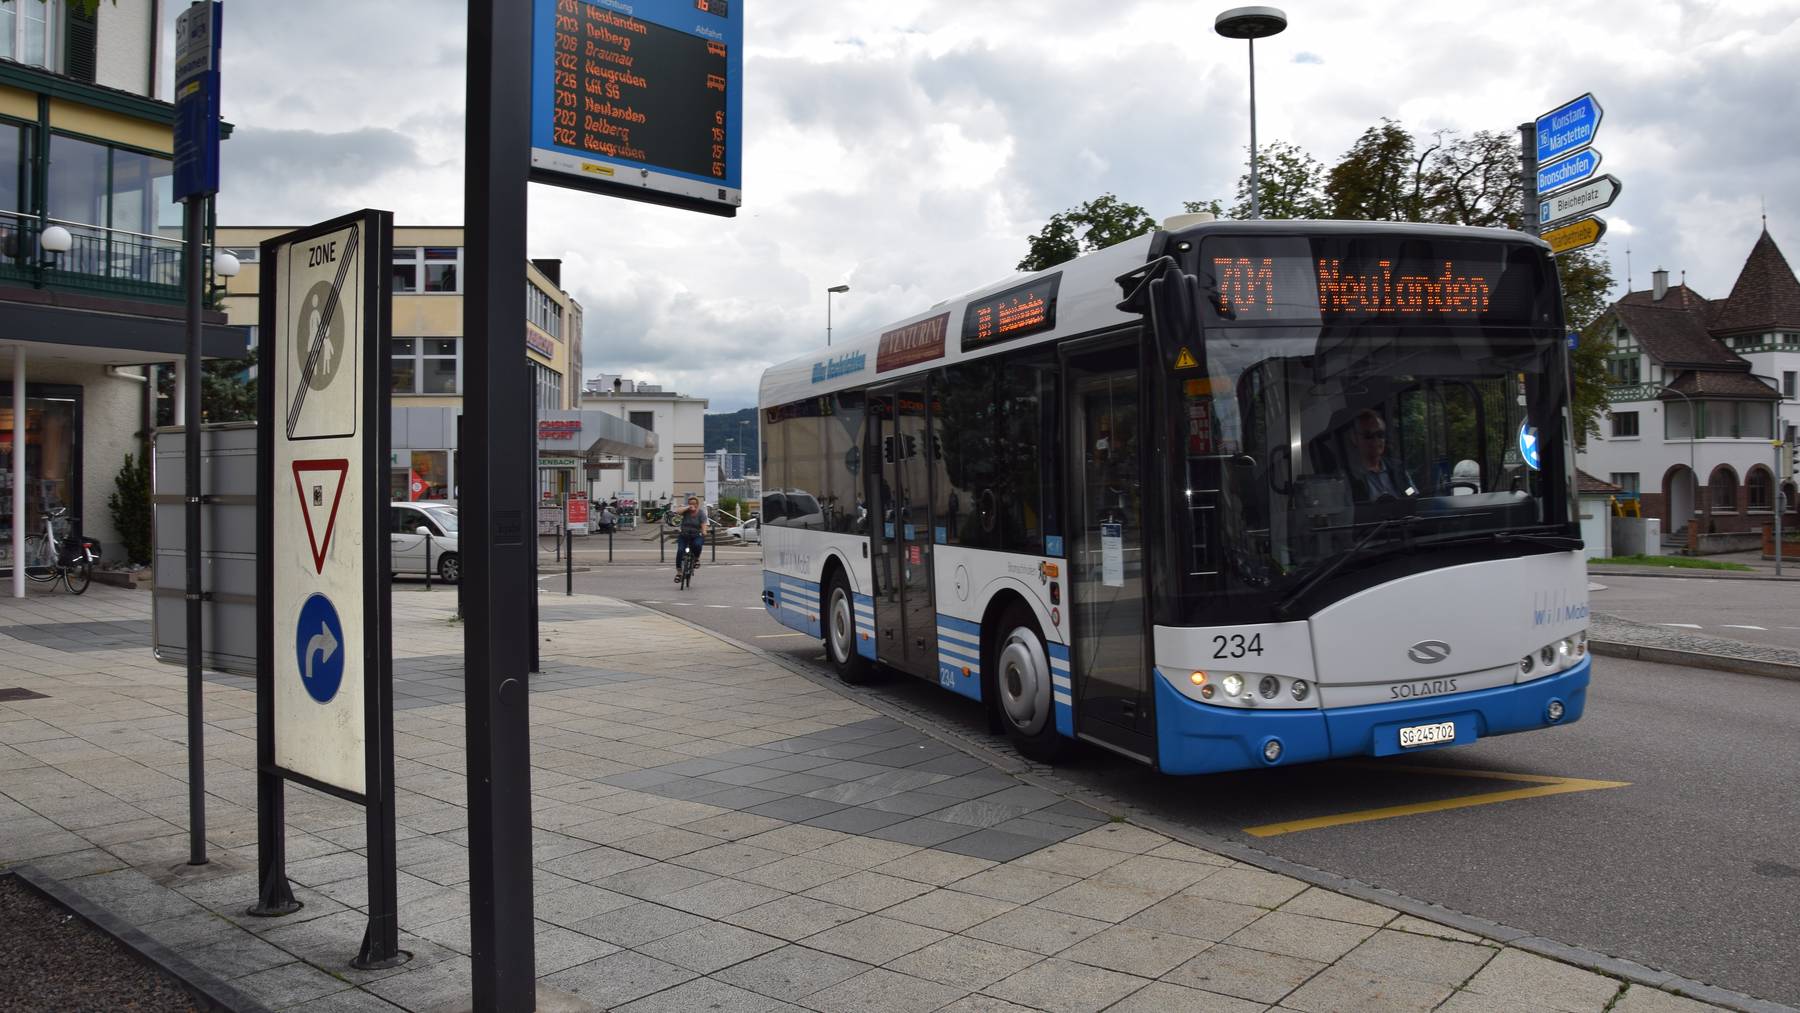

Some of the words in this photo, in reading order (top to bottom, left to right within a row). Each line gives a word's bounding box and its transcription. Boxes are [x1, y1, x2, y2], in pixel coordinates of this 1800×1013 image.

[555, 14, 579, 32] 703
[586, 4, 647, 35] Neulanden
[585, 41, 634, 67] Braunau
[555, 51, 578, 70] 702
[585, 59, 647, 88] Neugruben
[555, 70, 577, 89] 726
[553, 108, 577, 127] 703
[555, 89, 577, 107] 701
[585, 96, 646, 124] Neulanden
[1552, 106, 1586, 131] Konstanz
[553, 127, 577, 146] 702
[584, 133, 647, 160] Neugruben
[1550, 124, 1590, 151] Märstetten
[1539, 158, 1589, 188] Bronschhofen
[1557, 189, 1599, 212] Bleicheplatz
[309, 241, 336, 267] ZONE
[1214, 258, 1272, 311] 701
[1319, 259, 1489, 312] Neulanden
[1213, 633, 1264, 659] 234
[940, 667, 956, 689] 234
[1391, 680, 1457, 699] SOLARIS
